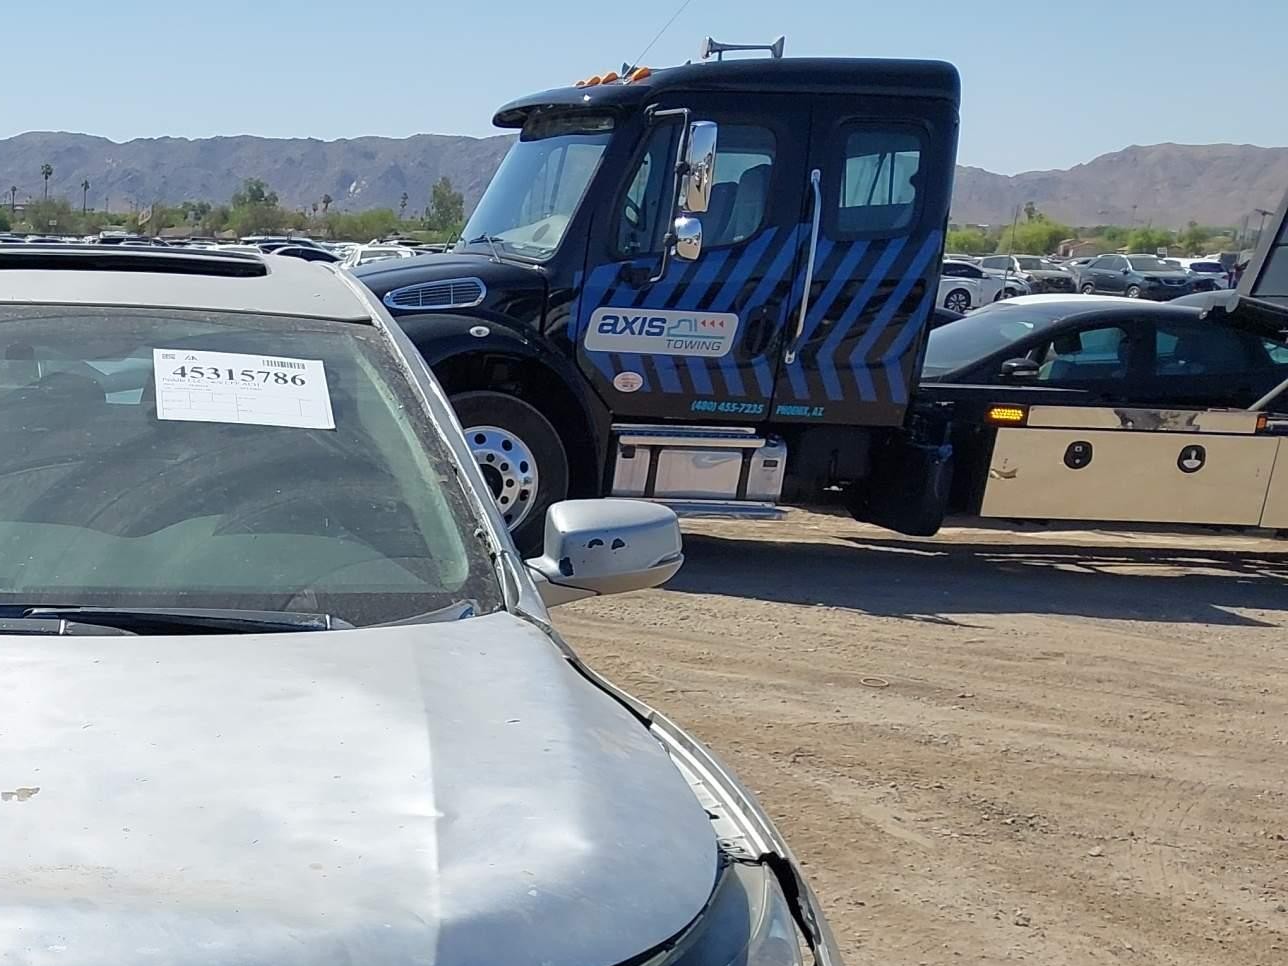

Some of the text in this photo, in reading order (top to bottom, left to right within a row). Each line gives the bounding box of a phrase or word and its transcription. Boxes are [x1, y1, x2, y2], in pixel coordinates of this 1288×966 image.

[666, 339, 722, 351] TOWING
[172, 365, 306, 387] 45315786
[811, 406, 825, 417] AZ
